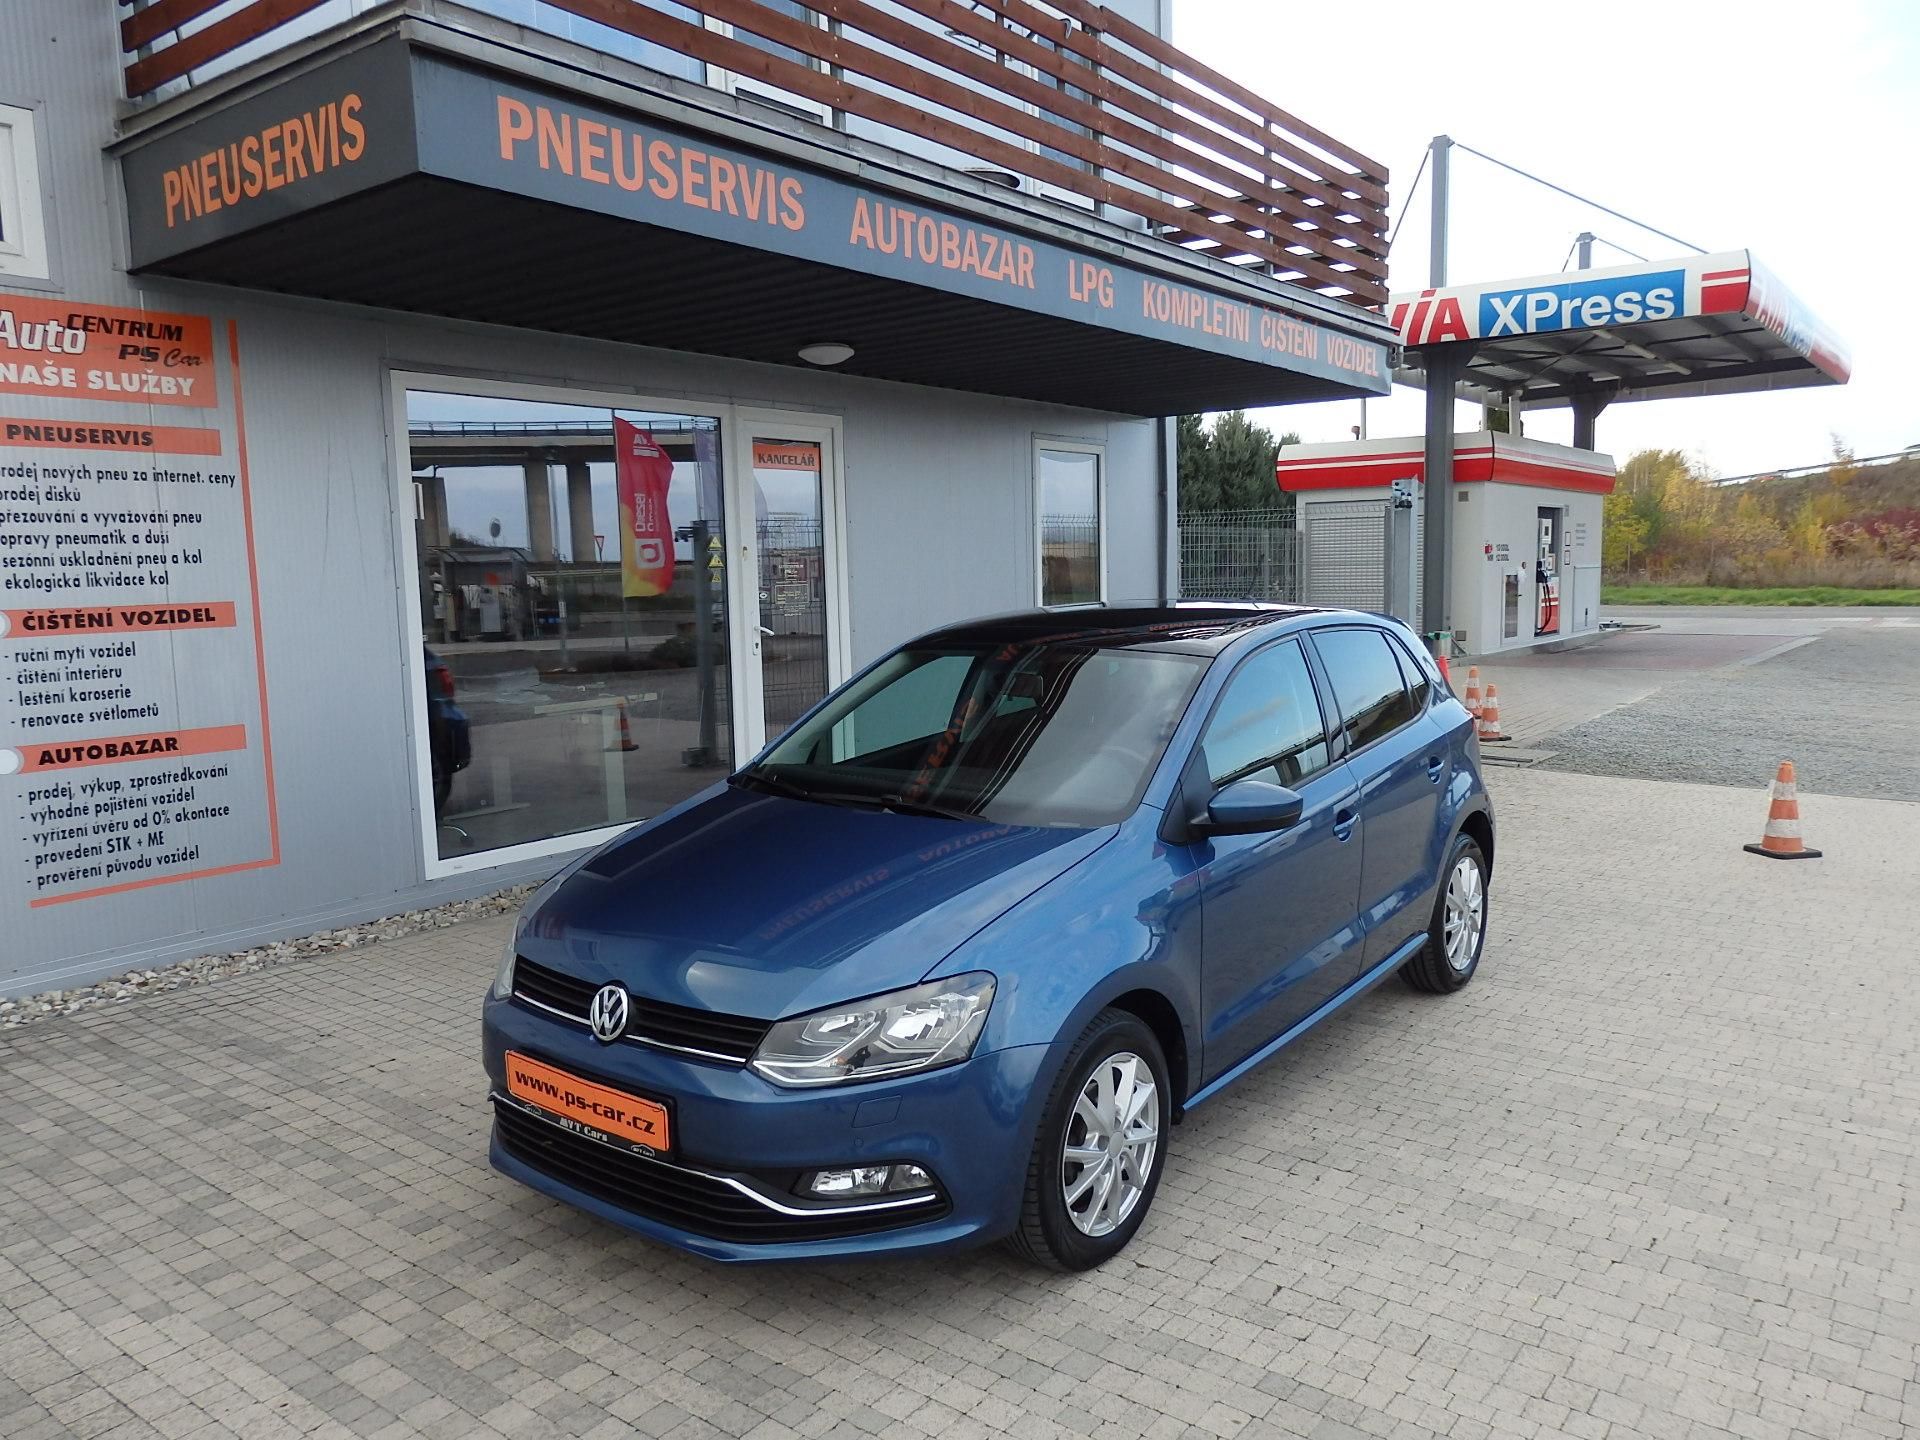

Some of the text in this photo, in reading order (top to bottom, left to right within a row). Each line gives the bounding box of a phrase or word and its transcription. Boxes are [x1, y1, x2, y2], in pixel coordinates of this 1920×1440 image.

[162, 93, 366, 228] PNEUSERVIS
[497, 96, 804, 231] PNEUSERVIS
[850, 197, 1035, 288] AUTOBAZAR
[1069, 259, 1114, 308] LPG
[1143, 280, 1252, 343] KOMPLETNÍ
[1326, 334, 1378, 377] VOZIDEL
[1488, 287, 1676, 337] XPress
[0, 309, 184, 355] Auto CENTRUM
[118, 343, 161, 363] PS
[0, 359, 196, 396] NAŠE SLUŽBY
[6, 424, 154, 447] PNEUSERVIS
[757, 452, 815, 467] KANCELÁŘ
[0, 462, 38, 482] rodej
[42, 463, 92, 484] nových
[96, 469, 128, 484] pneu
[132, 470, 148, 481] za
[208, 473, 236, 488] ceny
[0, 484, 40, 505] rodej
[81, 512, 89, 523] a
[93, 509, 169, 528] vyvažování
[173, 513, 202, 527] pneu
[0, 534, 50, 549] opravy
[56, 528, 127, 549] pneumatik
[132, 533, 139, 544] a
[3, 548, 202, 568] sezónní uskladnění pneu a kol
[5, 570, 169, 593] ekologická likvidace kol
[22, 607, 216, 631] ČIŠTĚNÍ VOZIDEL
[15, 648, 49, 663] ruční
[89, 640, 136, 659] vozidel
[17, 664, 122, 685] čištění interiéru
[19, 683, 132, 707] leštění karoserie
[21, 703, 159, 728] renovace světlometů
[38, 736, 180, 766] AUTOBAZAR
[130, 763, 228, 790] zprostředkování
[31, 786, 195, 826] výhodné pojištění vozidel
[32, 805, 230, 847] vyřízení úvěru od 0% akontace
[35, 843, 103, 869] provedení
[107, 836, 132, 854] STK
[147, 831, 165, 848] ME
[37, 845, 199, 890] prověření původu vozidel
[515, 1071, 656, 1136] www.ps-car.cz
